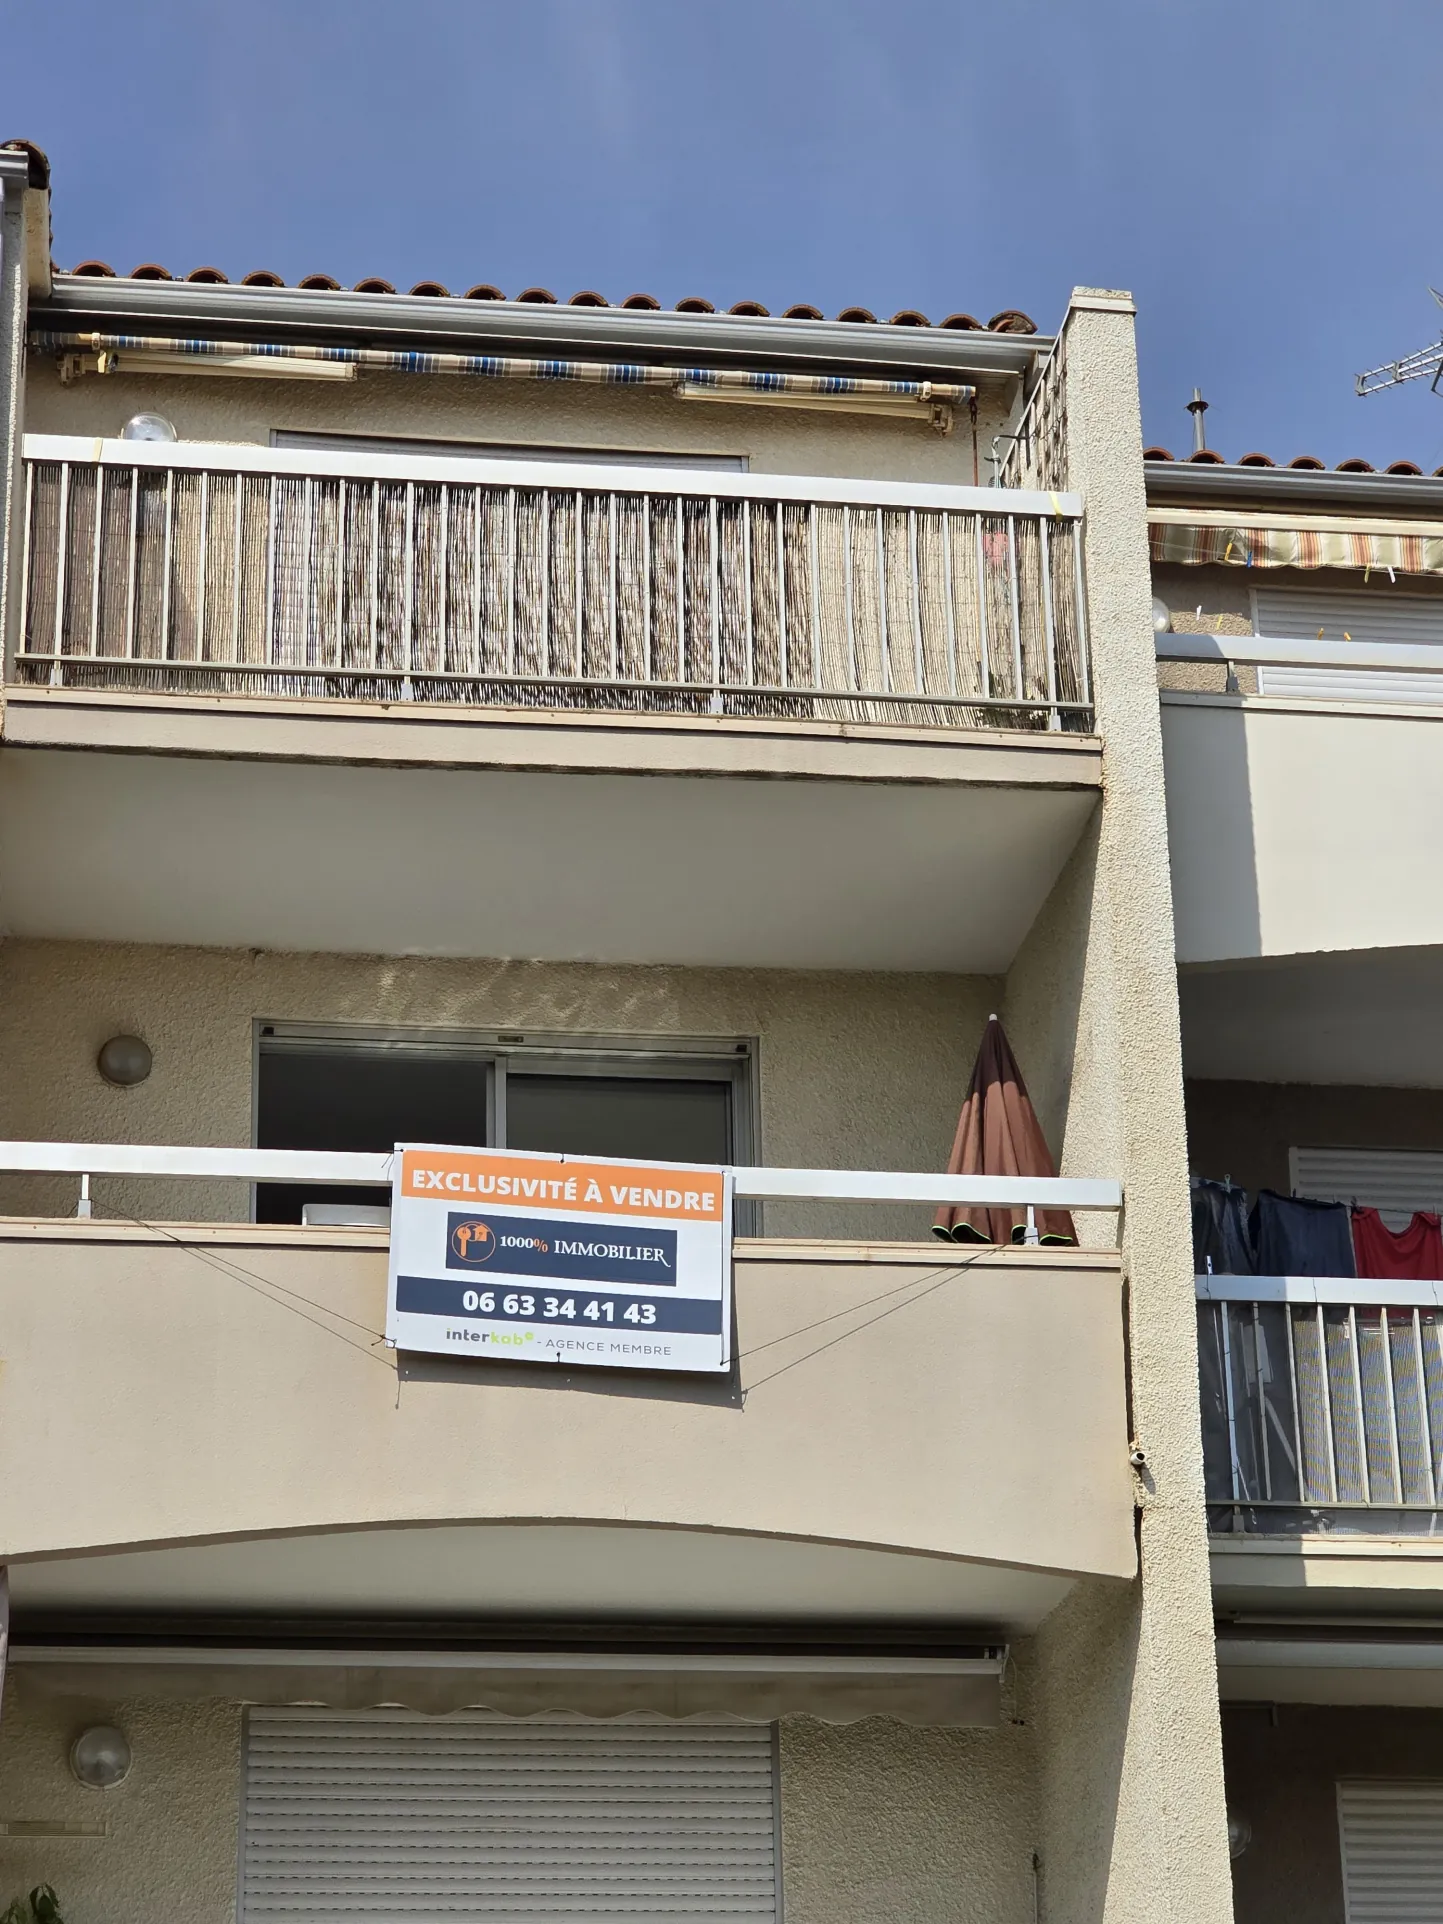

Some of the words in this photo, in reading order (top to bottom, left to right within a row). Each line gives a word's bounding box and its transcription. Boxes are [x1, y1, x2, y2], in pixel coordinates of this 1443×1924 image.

[412, 1169, 577, 1201] EXCLUSIVITÉ
[583, 1178, 604, 1204] À
[610, 1185, 715, 1211] VENDRE
[500, 1235, 548, 1253] 1000%
[554, 1240, 671, 1267] IMMOBILIER
[462, 1290, 495, 1312] 06
[503, 1293, 536, 1316] 63
[543, 1297, 576, 1319] 34
[583, 1300, 614, 1322] 41
[623, 1303, 656, 1324] 43
[545, 1338, 605, 1352] AGENCE
[610, 1343, 672, 1356] MEMBRE
